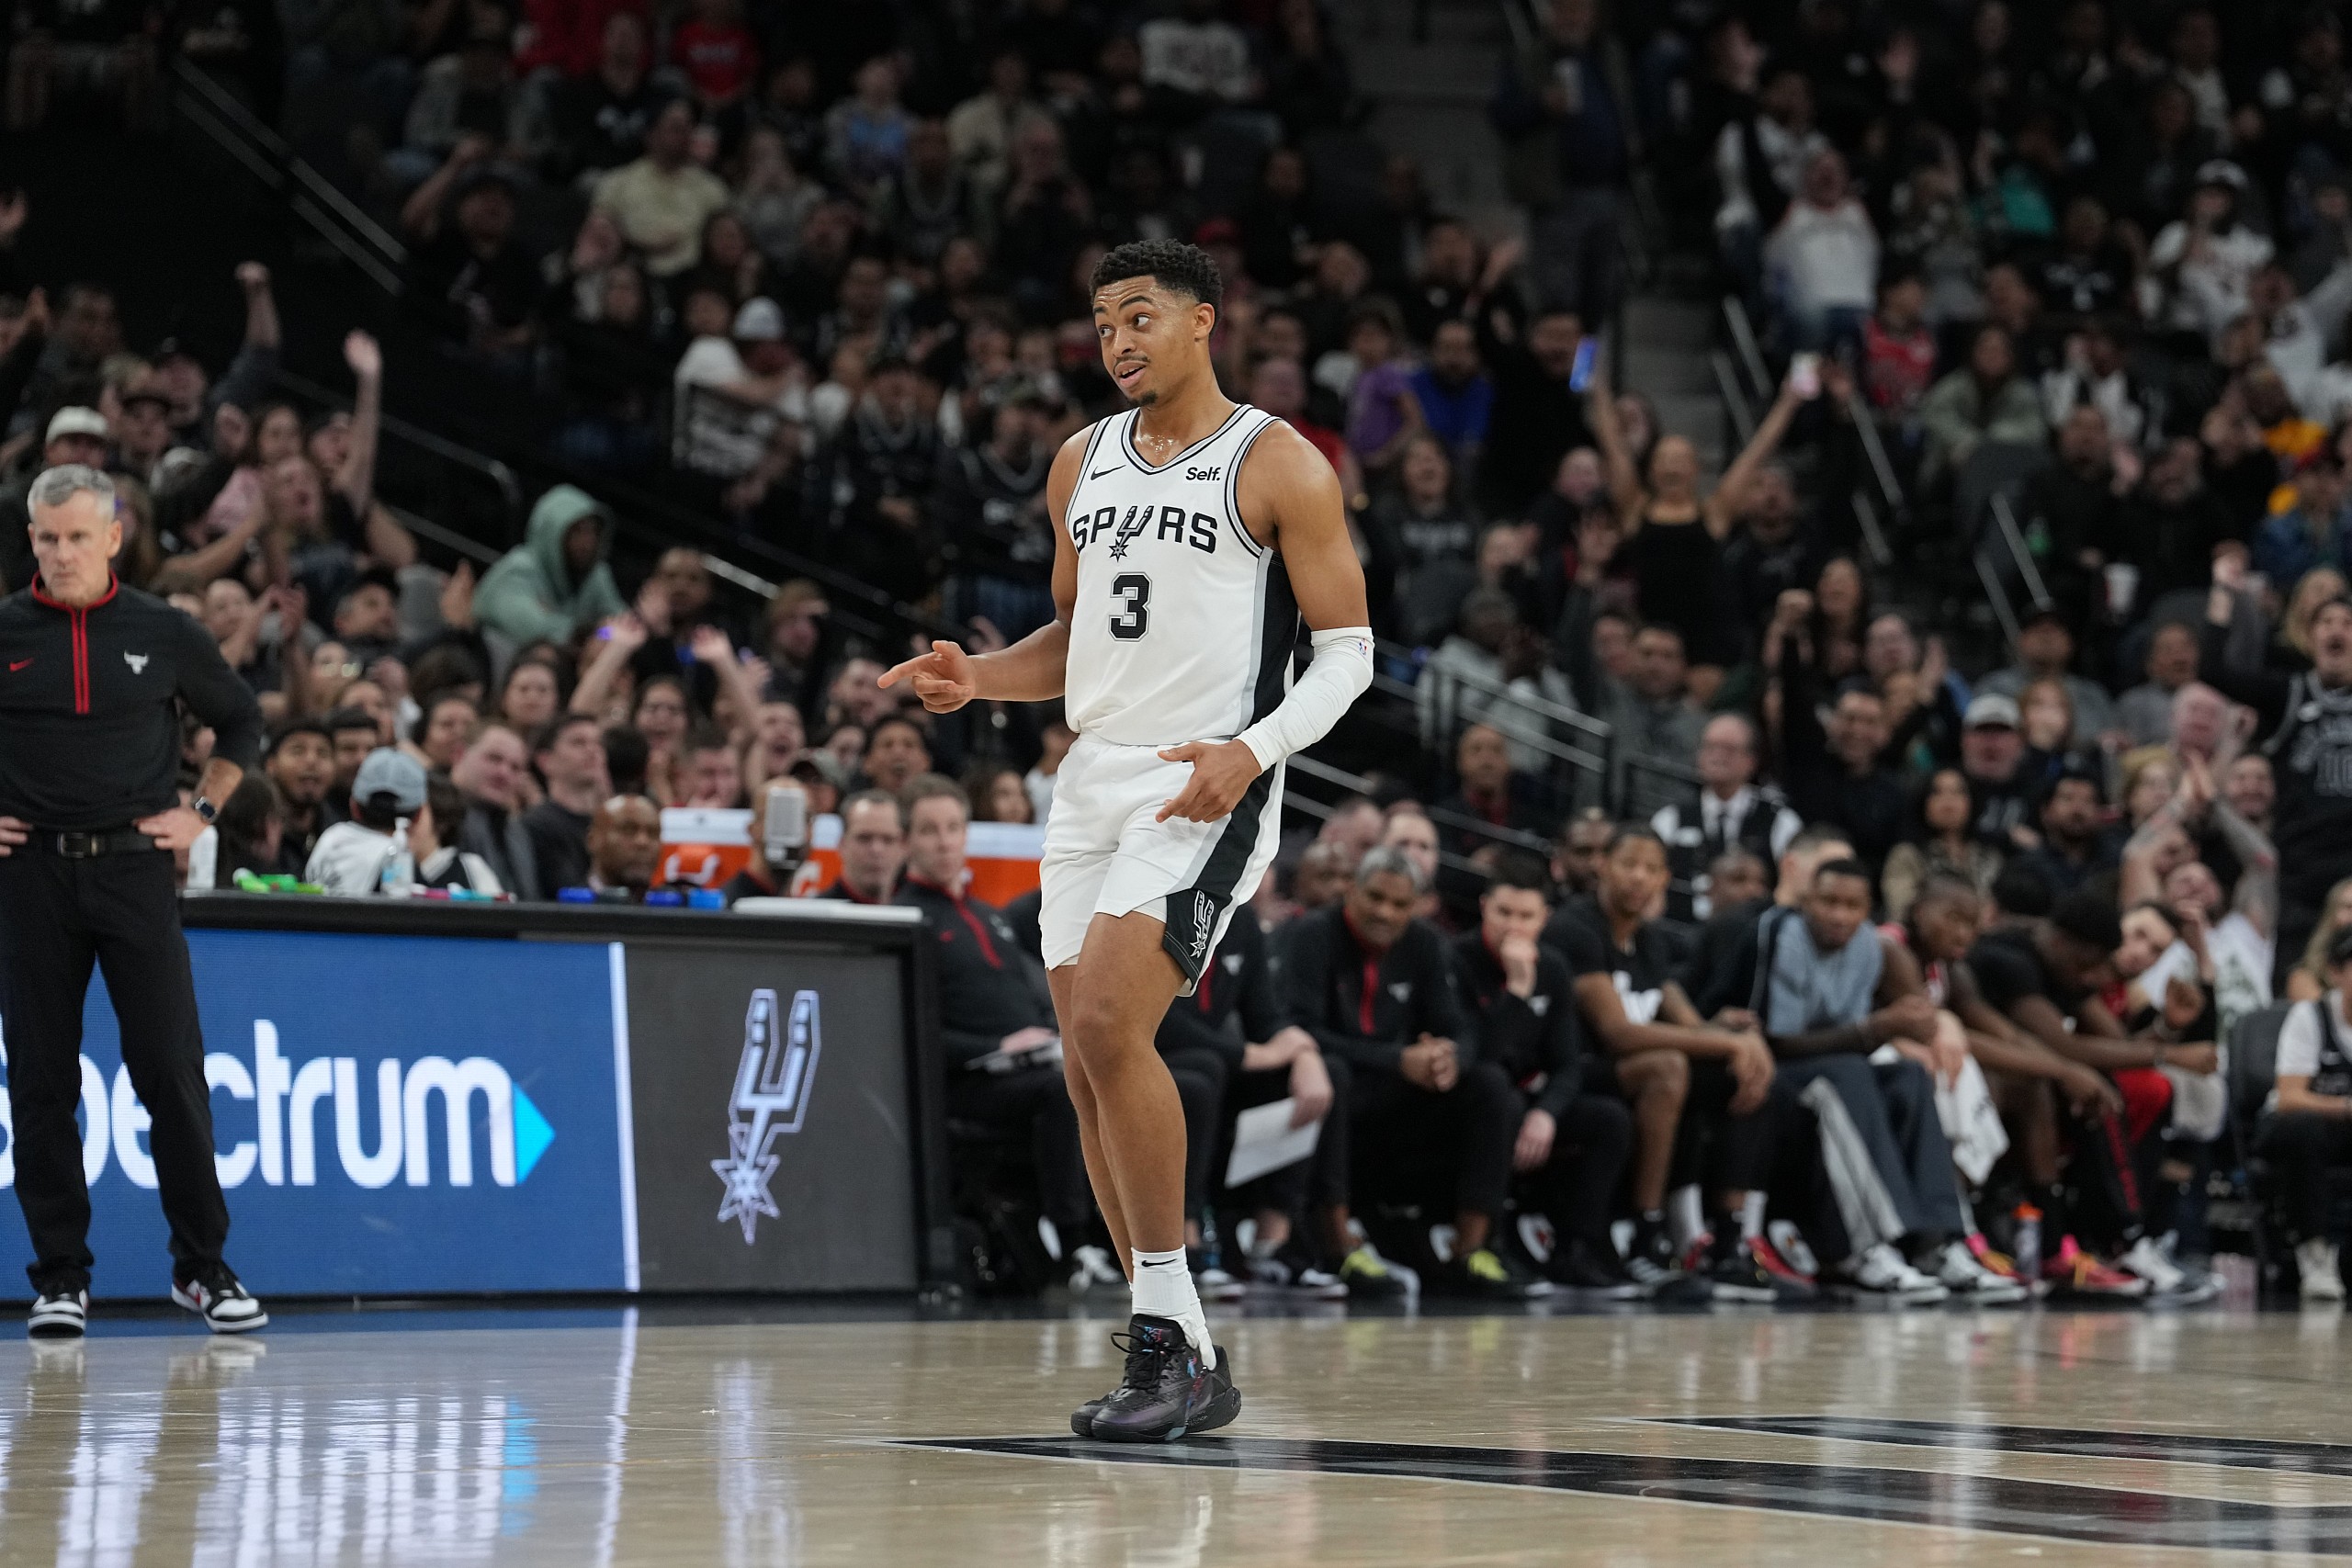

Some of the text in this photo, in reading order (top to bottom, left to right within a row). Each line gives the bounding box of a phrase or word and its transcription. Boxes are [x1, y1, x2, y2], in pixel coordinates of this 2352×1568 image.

[1185, 467, 1221, 481] Self.
[1073, 505, 1218, 562] SPURS
[1108, 571, 1153, 643] 3
